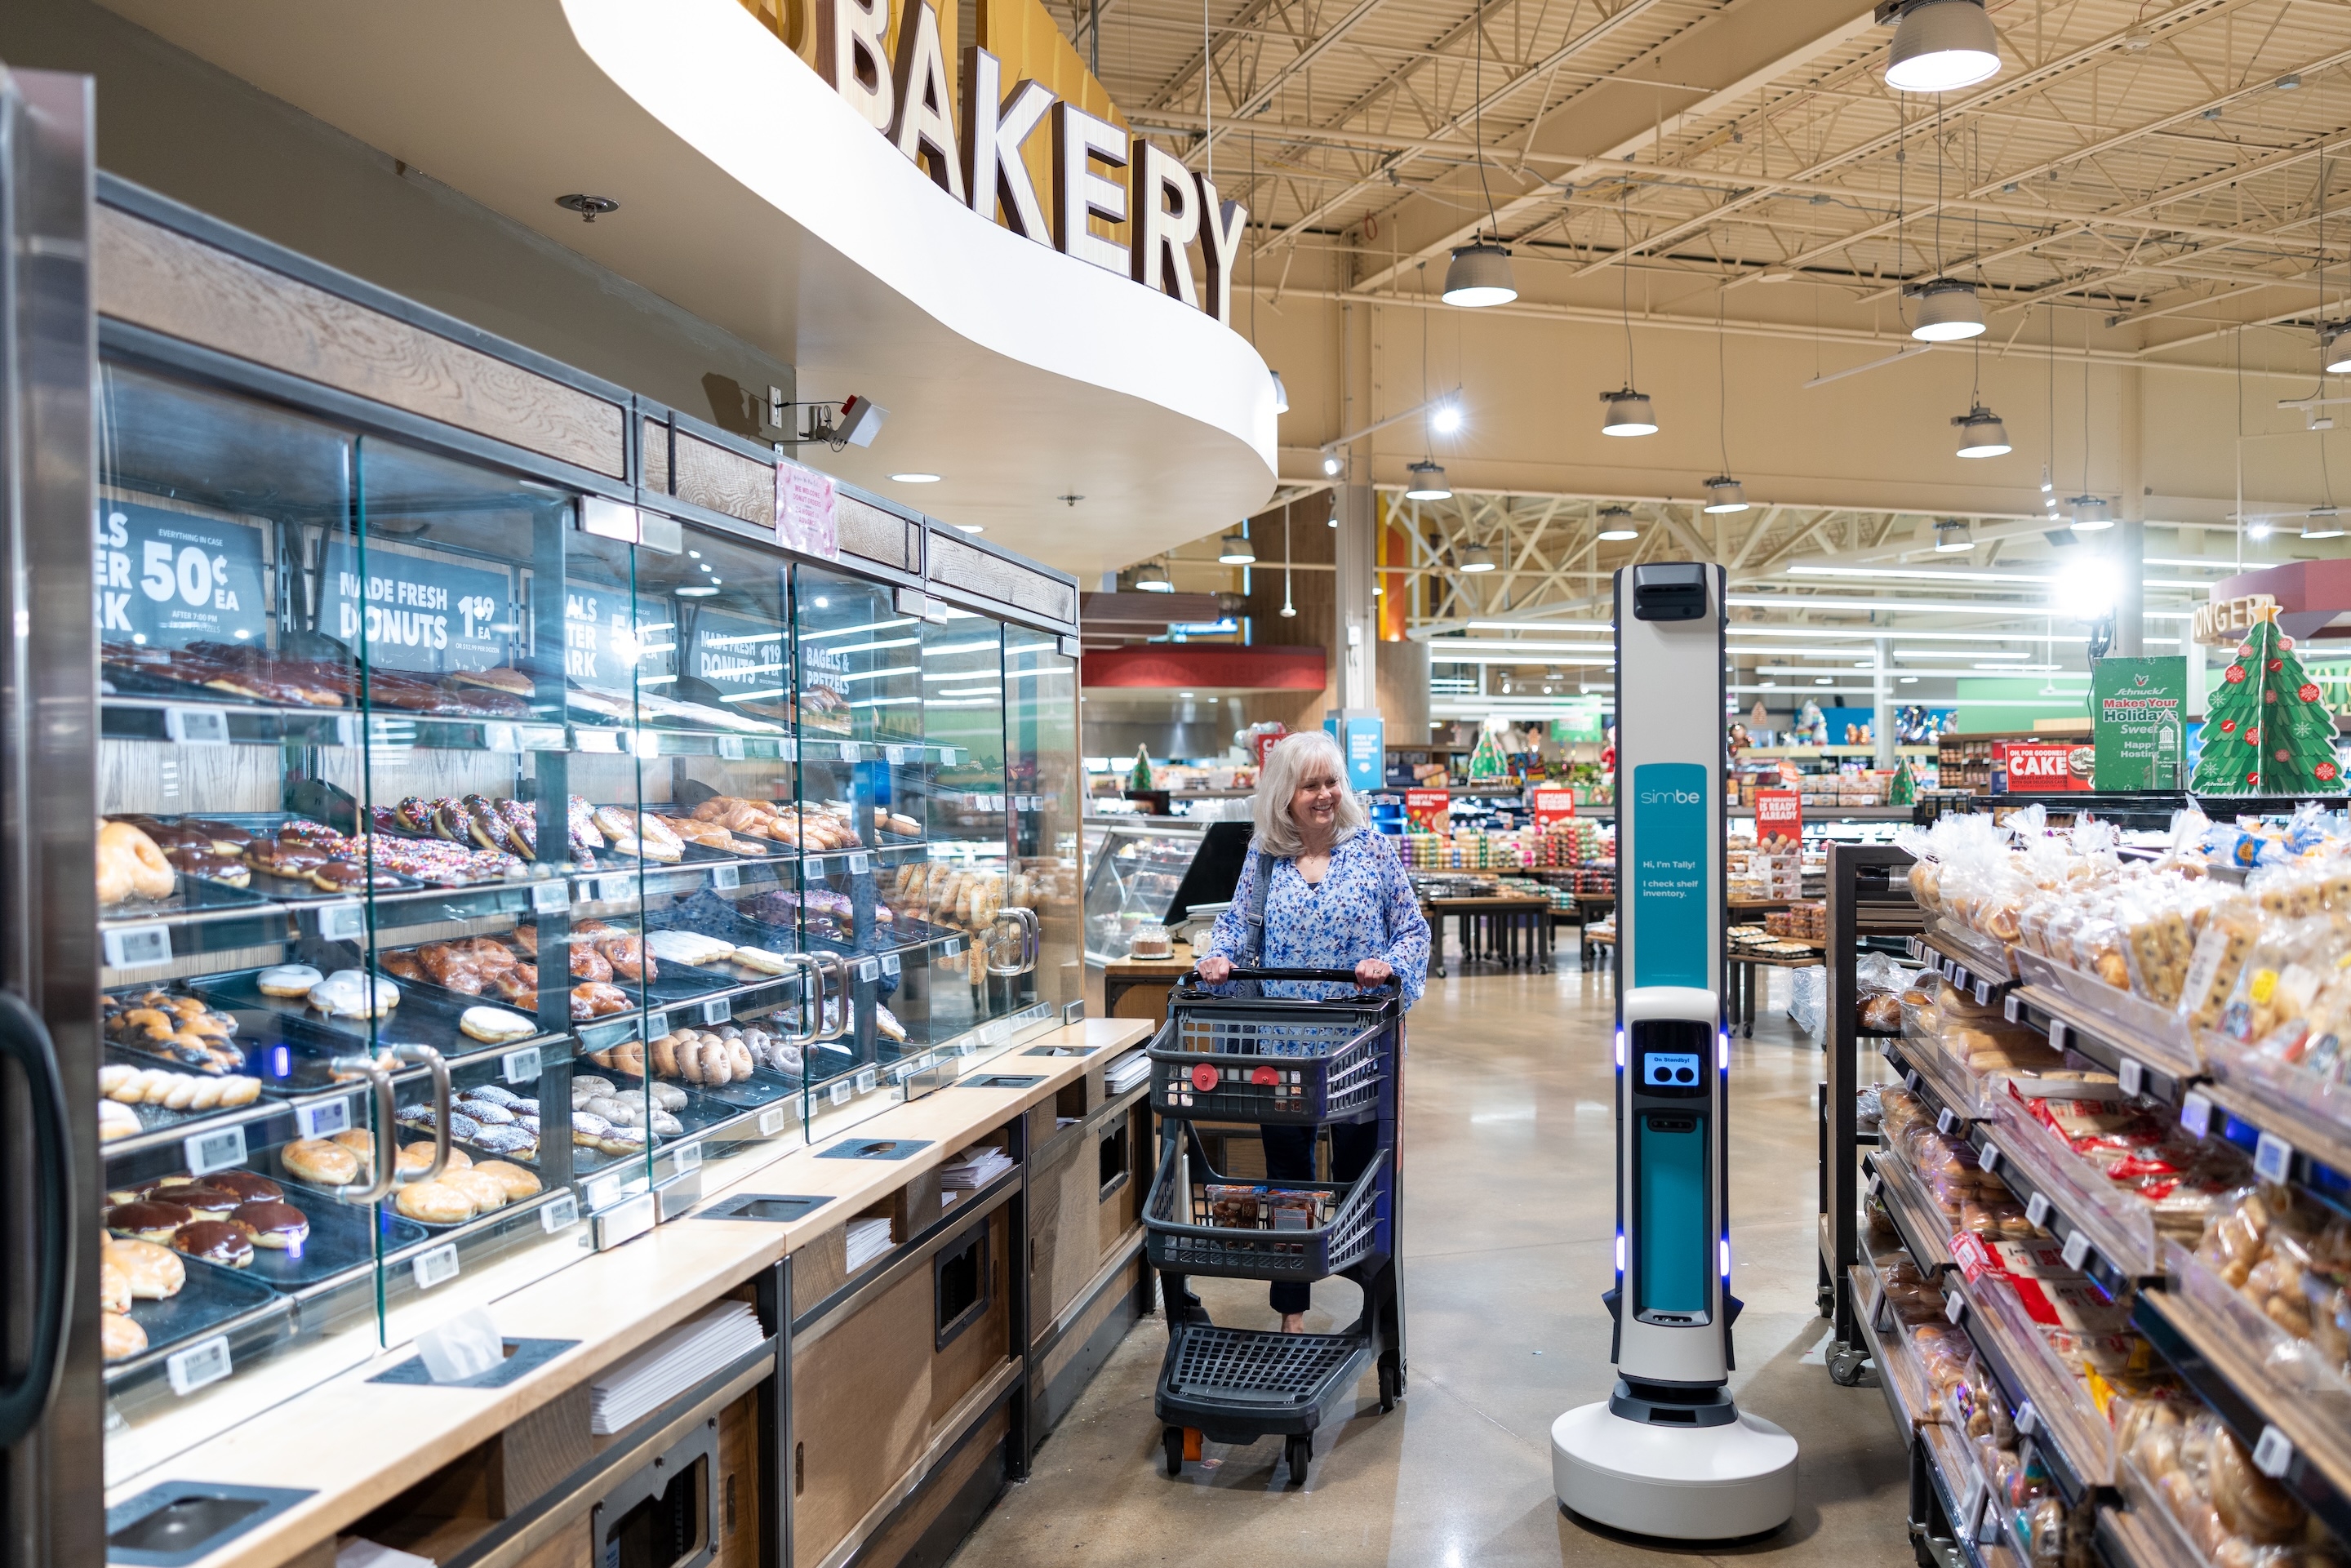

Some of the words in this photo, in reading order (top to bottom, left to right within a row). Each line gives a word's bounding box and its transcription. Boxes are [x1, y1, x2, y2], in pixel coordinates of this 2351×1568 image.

[826, 0, 1249, 326] BAKERY
[802, 486, 820, 499] WELCOME
[158, 528, 198, 543] EVERYTHING
[199, 535, 207, 544] IN
[207, 536, 224, 547] CASE
[215, 589, 239, 611] EA
[398, 581, 447, 611] FRESH
[172, 611, 192, 620] AFTER
[193, 613, 207, 622] 7:00
[207, 615, 218, 623] PM
[2194, 594, 2258, 637] ONGER
[340, 602, 448, 650] DONUTS
[478, 626, 491, 640] EA
[806, 646, 841, 671] BAGELS
[842, 652, 850, 673] &
[700, 651, 756, 685] DONUTS
[807, 670, 850, 695] PRETZELS
[2114, 687, 2168, 695] Schnucks
[2103, 698, 2146, 708] Makes
[2147, 698, 2179, 708] Your
[2103, 709, 2179, 724] Holidays
[2120, 724, 2159, 734] Sweet
[2124, 741, 2157, 750] Happy
[2120, 751, 2160, 759] Hosting
[2010, 756, 2068, 776] CAKE
[1641, 789, 1700, 804] simbe
[1759, 802, 1768, 811] IS
[1768, 802, 1798, 811] READY
[1760, 811, 1798, 820] ALREADY
[1643, 860, 1655, 868] Hi,
[1672, 861, 1695, 869] Tally!
[1643, 890, 1687, 899] inventory.
